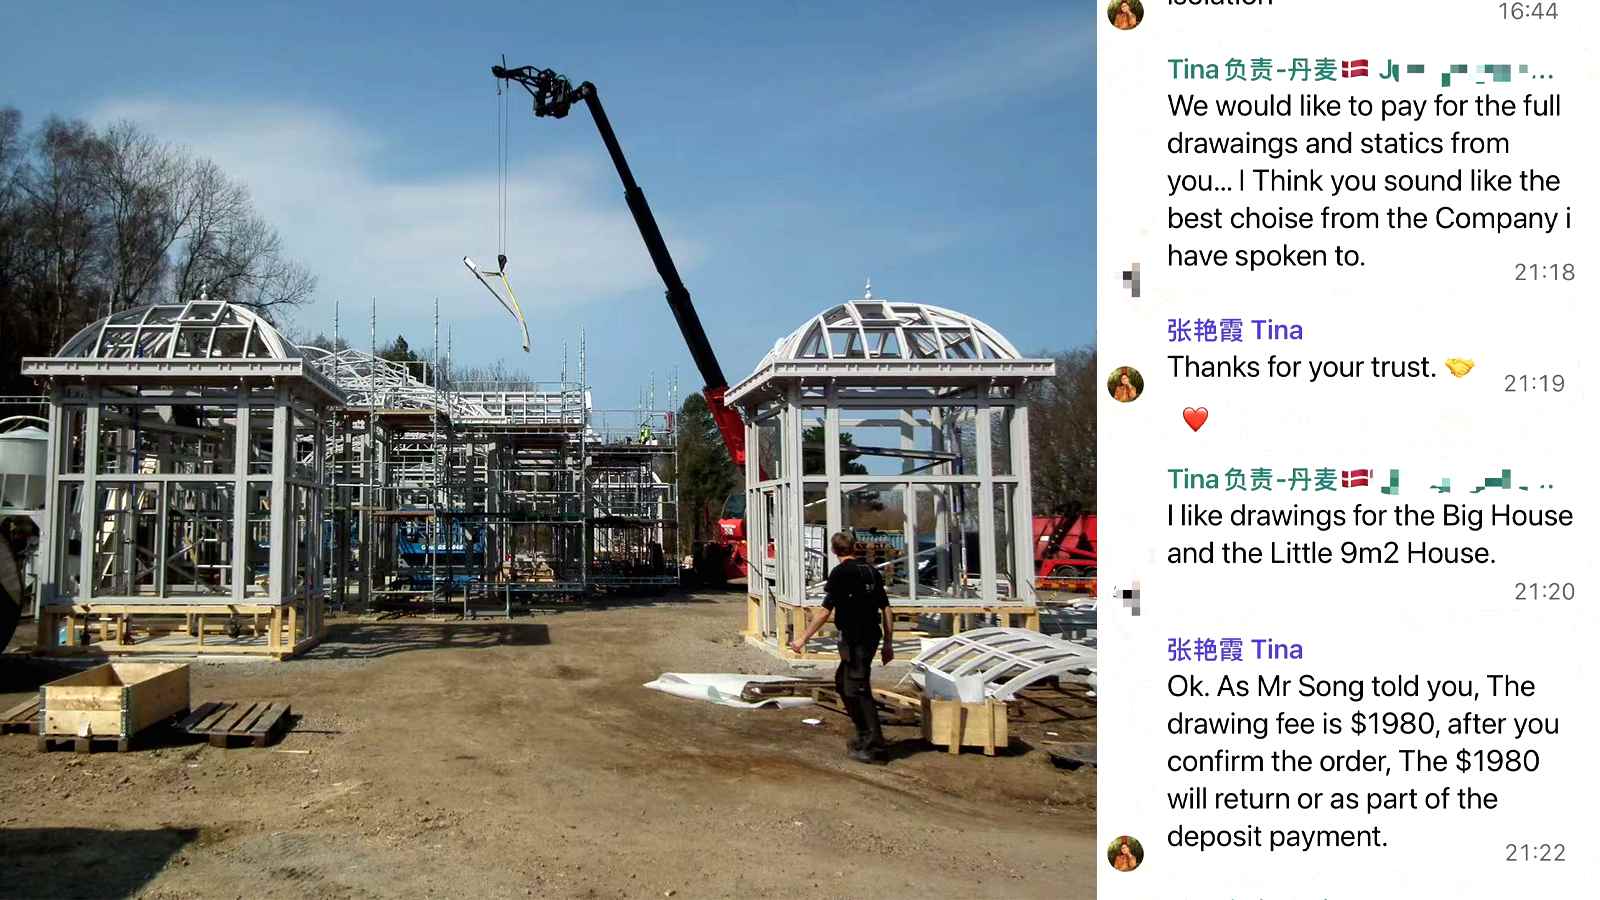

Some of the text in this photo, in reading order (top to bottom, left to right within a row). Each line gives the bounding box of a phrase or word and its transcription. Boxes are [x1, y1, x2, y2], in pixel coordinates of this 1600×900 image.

[1498, 1, 1559, 20] 16:44
[1167, 93, 1561, 122] We would like to pay for the full
[1167, 130, 1509, 160] drawaings and statics from
[1167, 168, 1561, 197] you... I Think you sound like the
[1168, 205, 1571, 234] best choise from the Company i
[1168, 243, 1365, 272] have spoken to.
[1515, 263, 1576, 281] 21:18
[1167, 317, 1303, 343] 张艳霞 Tina
[1167, 354, 1436, 383] Thanks for your trust.
[1504, 374, 1565, 393] 21:19
[1168, 503, 1574, 532] I like drawings for the Big House
[1167, 540, 1496, 564] and the Little 9m2 House.
[1515, 582, 1576, 601] 21:20
[1167, 637, 1303, 662] 张艳霞 Tina
[1167, 674, 1536, 703] Ok. As Mr Song told you, The
[1167, 709, 1559, 740] drawing fee is $1980, after you
[1167, 747, 1540, 777] confirm the order, The $1980
[1167, 786, 1498, 815] will return or as part of the
[1167, 824, 1388, 852] deposit payment.
[1505, 843, 1567, 862] 21:22
